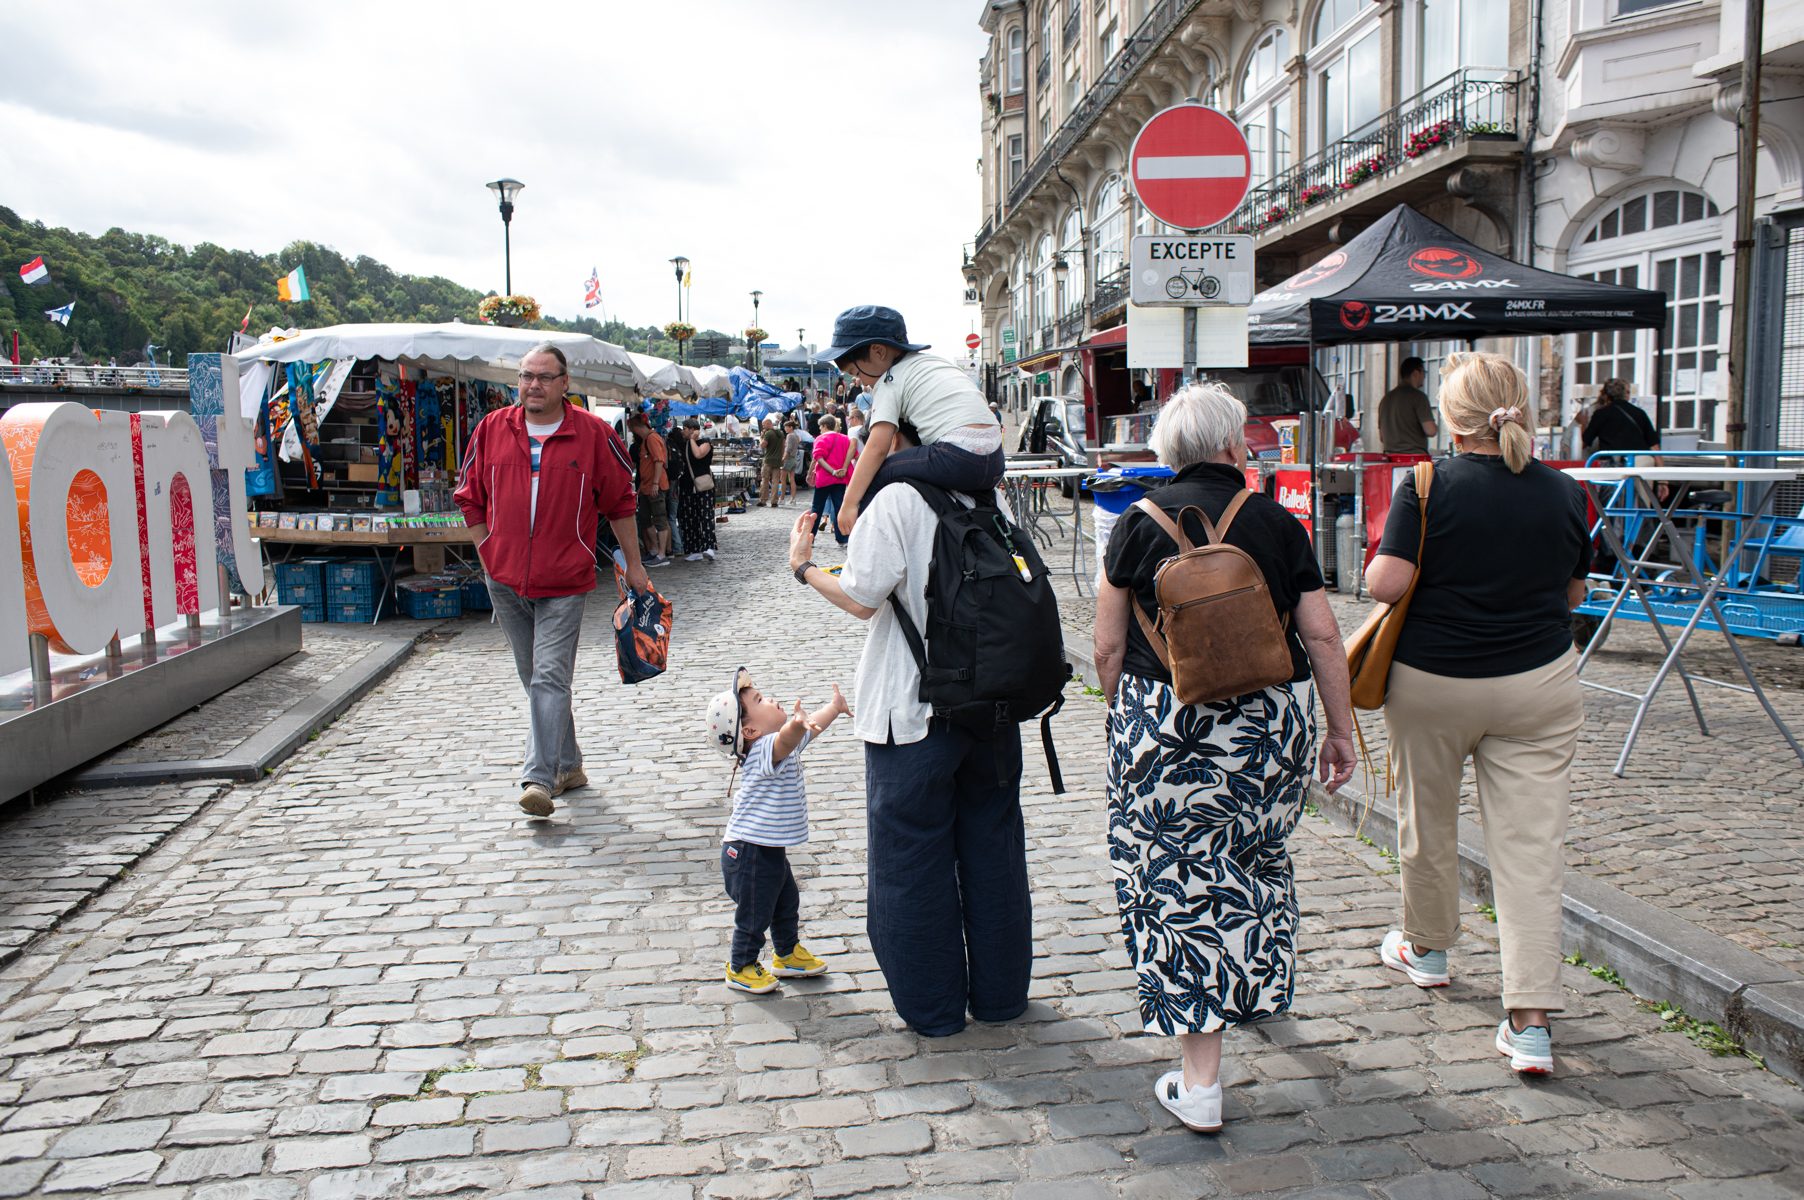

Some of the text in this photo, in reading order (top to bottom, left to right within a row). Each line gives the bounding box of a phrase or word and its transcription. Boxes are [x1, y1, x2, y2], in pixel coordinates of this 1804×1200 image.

[1150, 242, 1236, 260] EXCEPTE
[1409, 279, 1520, 292] 24MX
[1373, 301, 1476, 323] 24MX
[1505, 300, 1546, 310] 24MX.FR
[0, 352, 265, 677] ant
